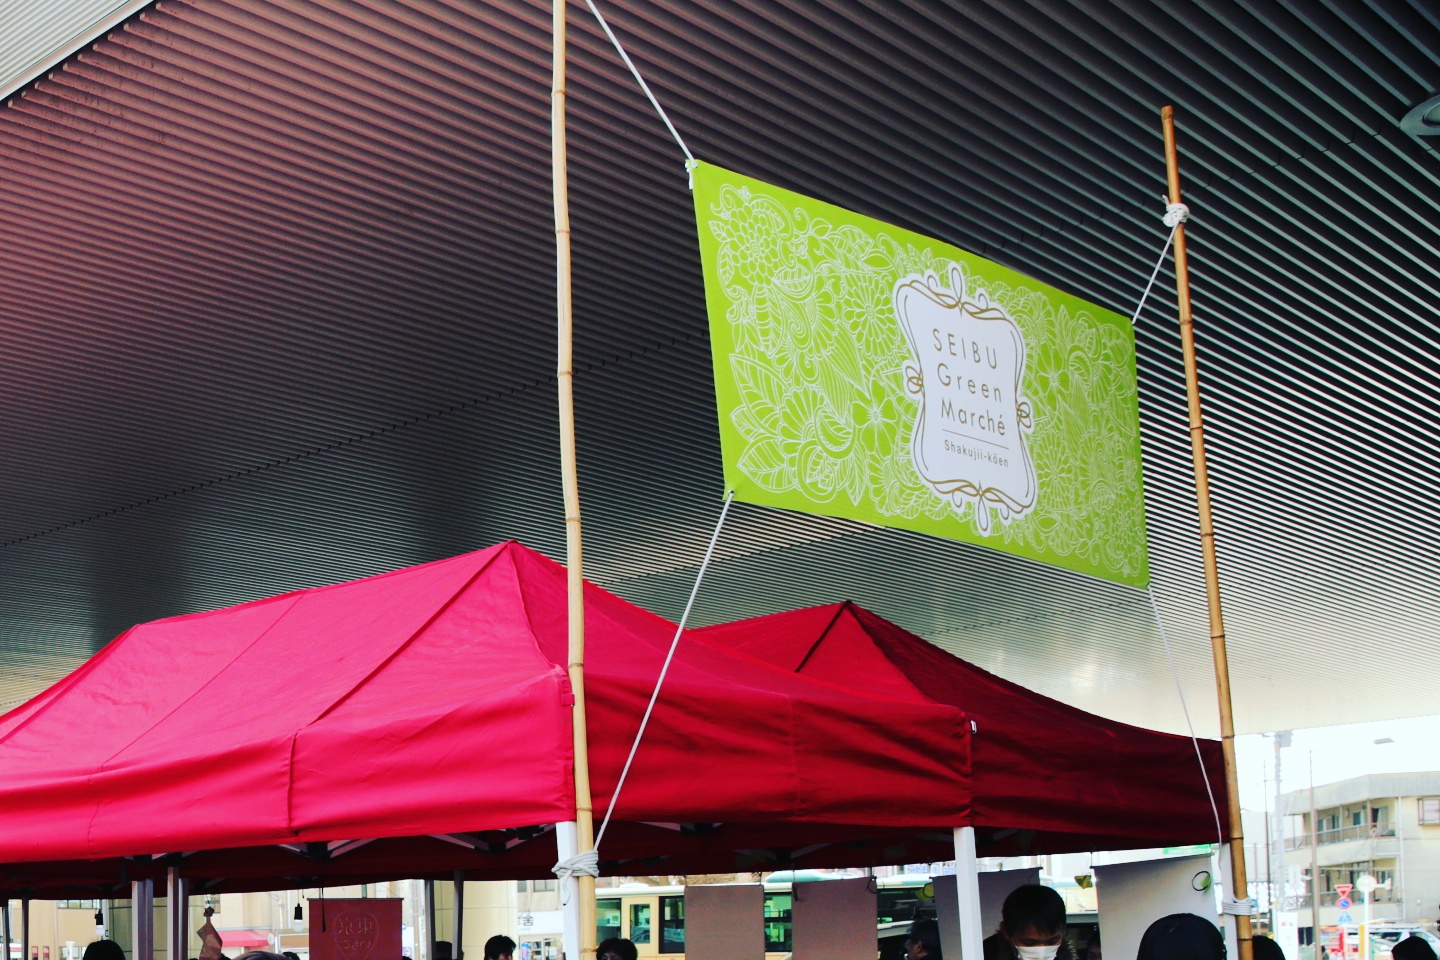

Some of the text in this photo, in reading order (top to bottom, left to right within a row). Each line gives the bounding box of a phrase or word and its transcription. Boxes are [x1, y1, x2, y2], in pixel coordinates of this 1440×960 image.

[932, 328, 998, 370] SEIBU
[937, 362, 1002, 403] Green
[941, 397, 1006, 436] Marché
[944, 439, 1009, 468] Shakujii-kōen
